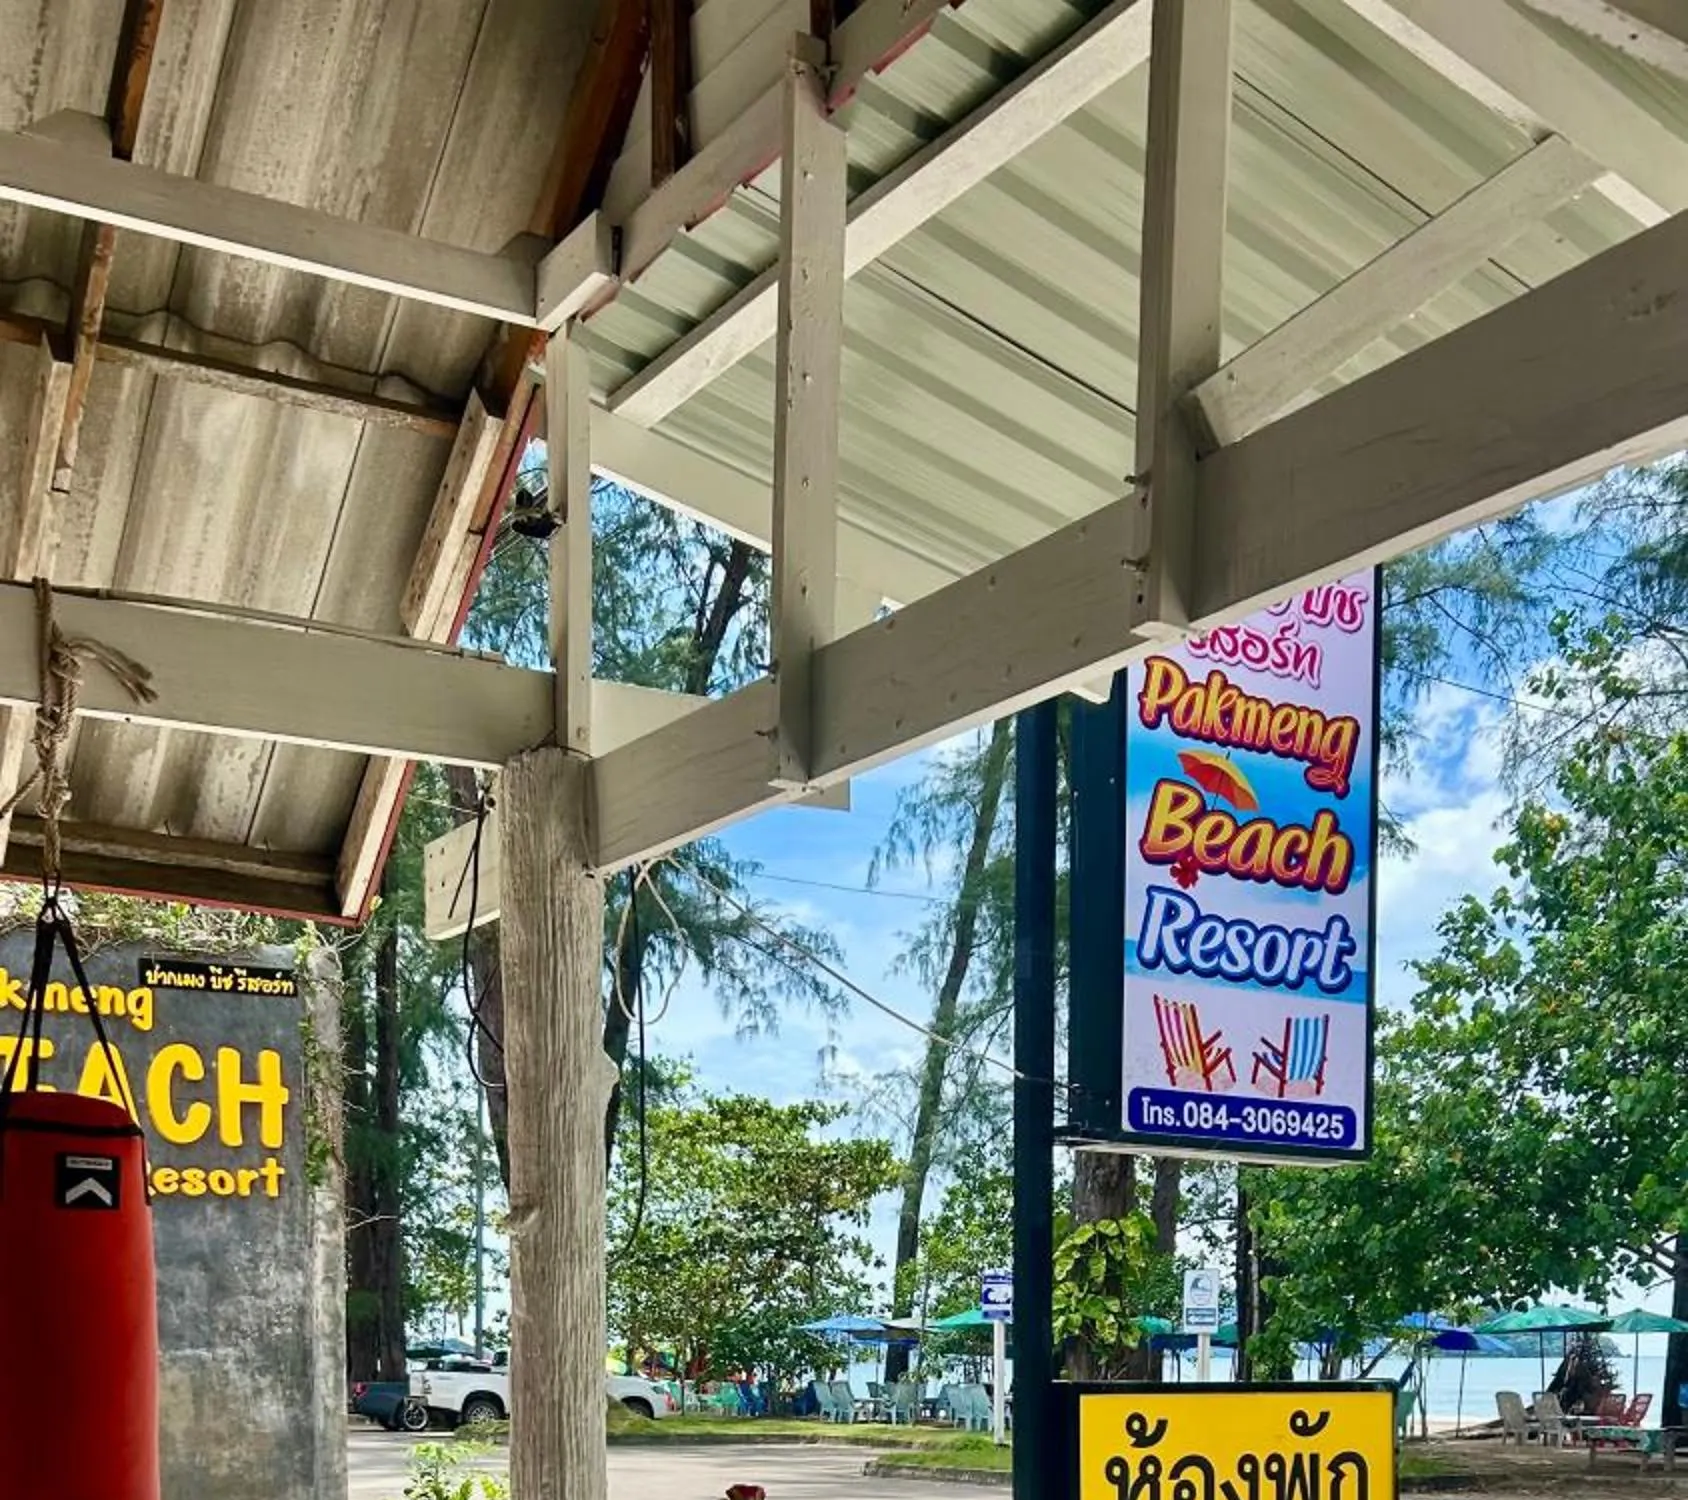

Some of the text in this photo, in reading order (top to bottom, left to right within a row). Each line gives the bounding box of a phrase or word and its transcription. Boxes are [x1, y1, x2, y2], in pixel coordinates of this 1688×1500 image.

[1139, 656, 1360, 799] Pakmeng
[1140, 778, 1353, 891] Beach
[1137, 885, 1356, 994] Resort
[145, 1157, 286, 1197] esort
